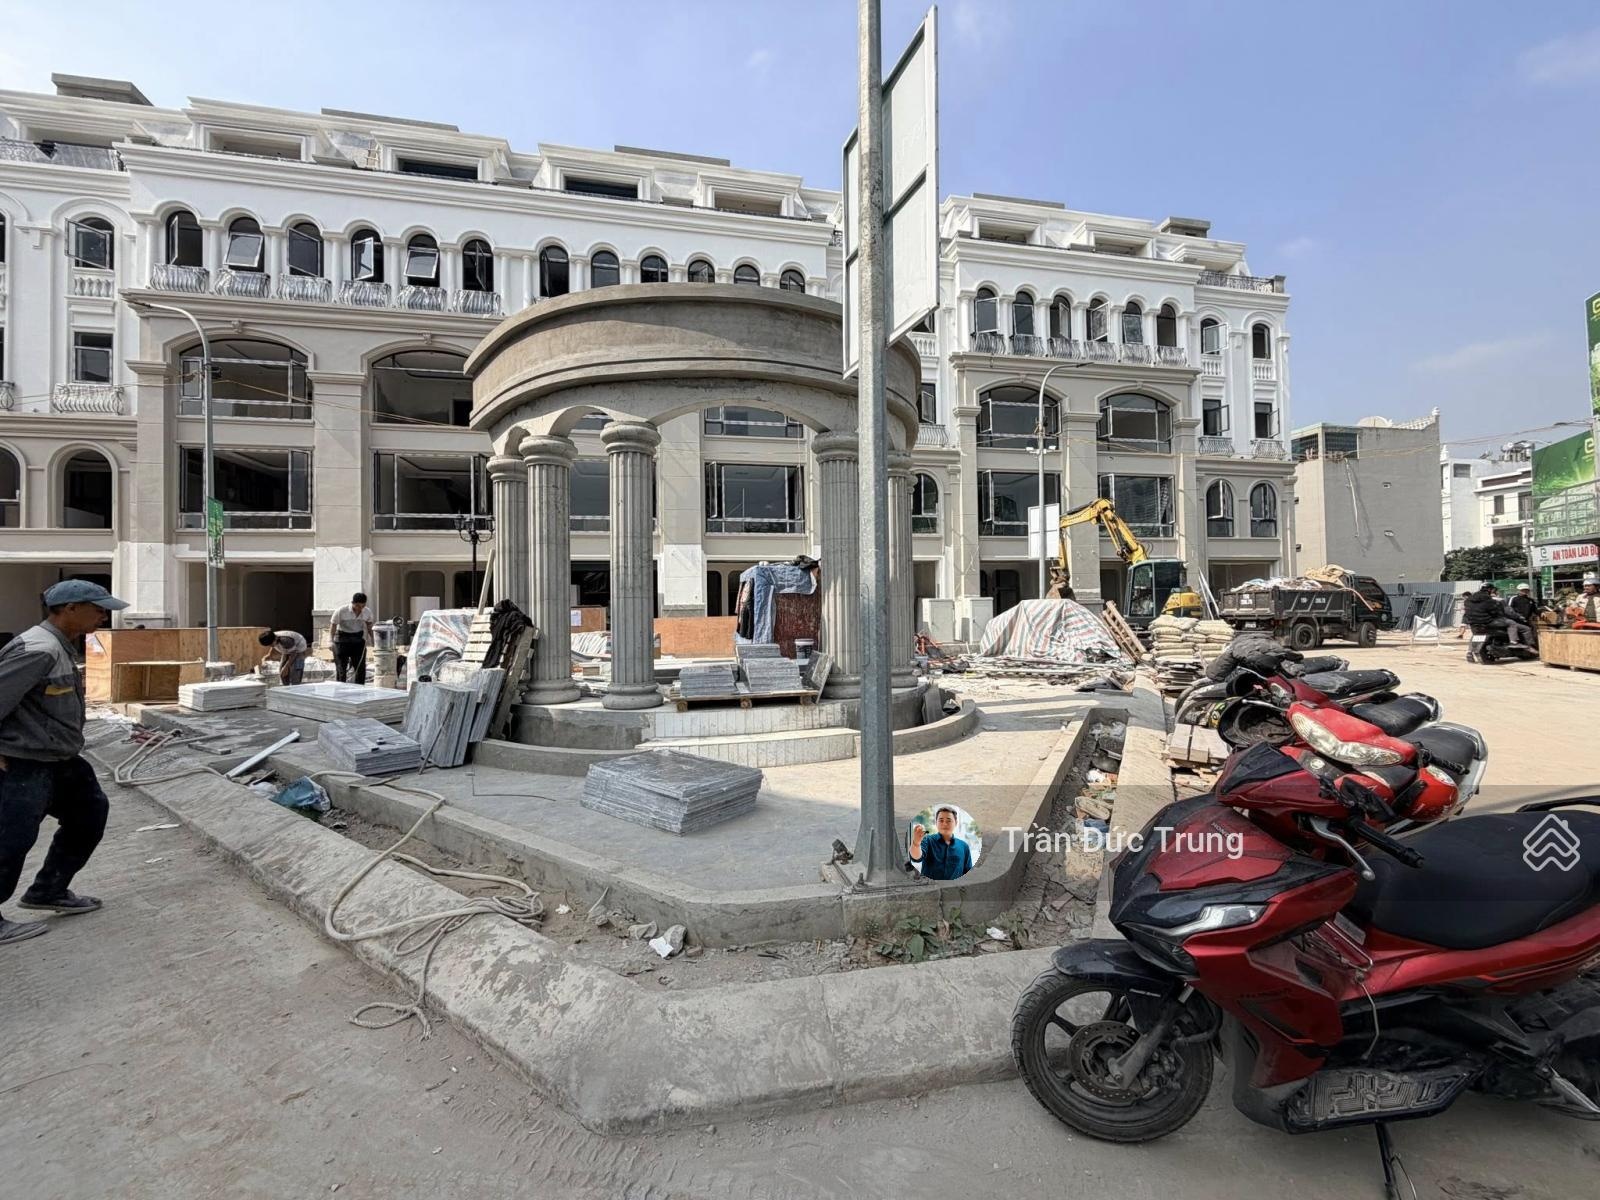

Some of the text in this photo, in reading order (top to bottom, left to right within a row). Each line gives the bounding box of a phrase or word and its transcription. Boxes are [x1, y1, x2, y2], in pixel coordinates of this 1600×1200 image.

[1552, 550, 1561, 561] AN
[1561, 545, 1577, 560] TOÀN
[1577, 545, 1589, 558] LAO
